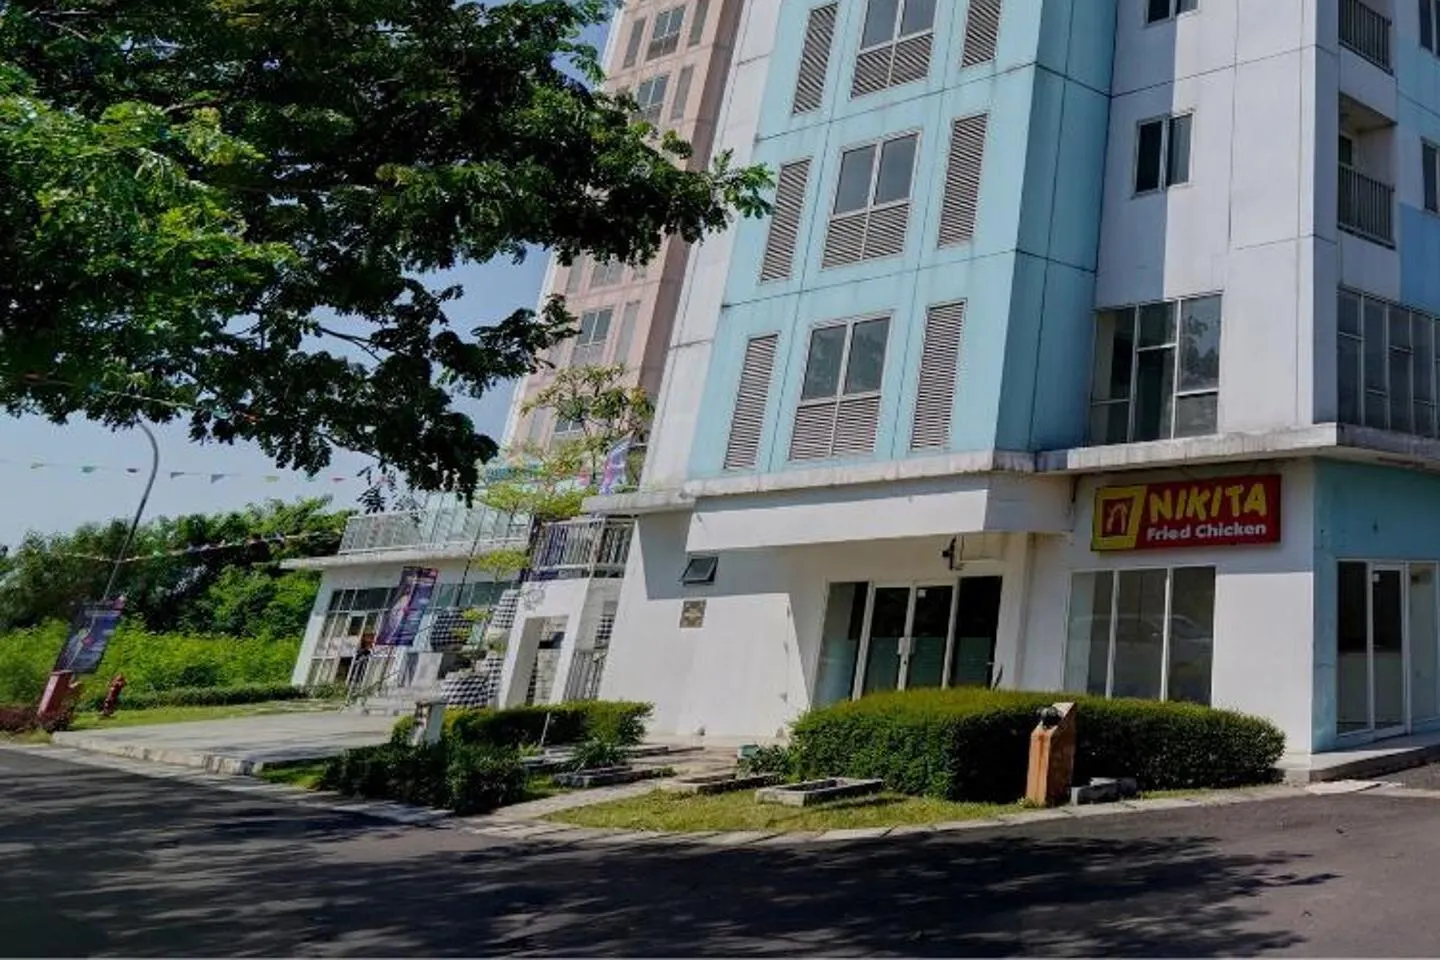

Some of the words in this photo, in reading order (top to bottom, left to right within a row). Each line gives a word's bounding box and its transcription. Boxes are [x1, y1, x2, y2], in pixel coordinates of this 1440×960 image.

[1150, 483, 1267, 523] NIKITA
[1147, 524, 1191, 541] Fried
[1195, 521, 1267, 538] Chicken
